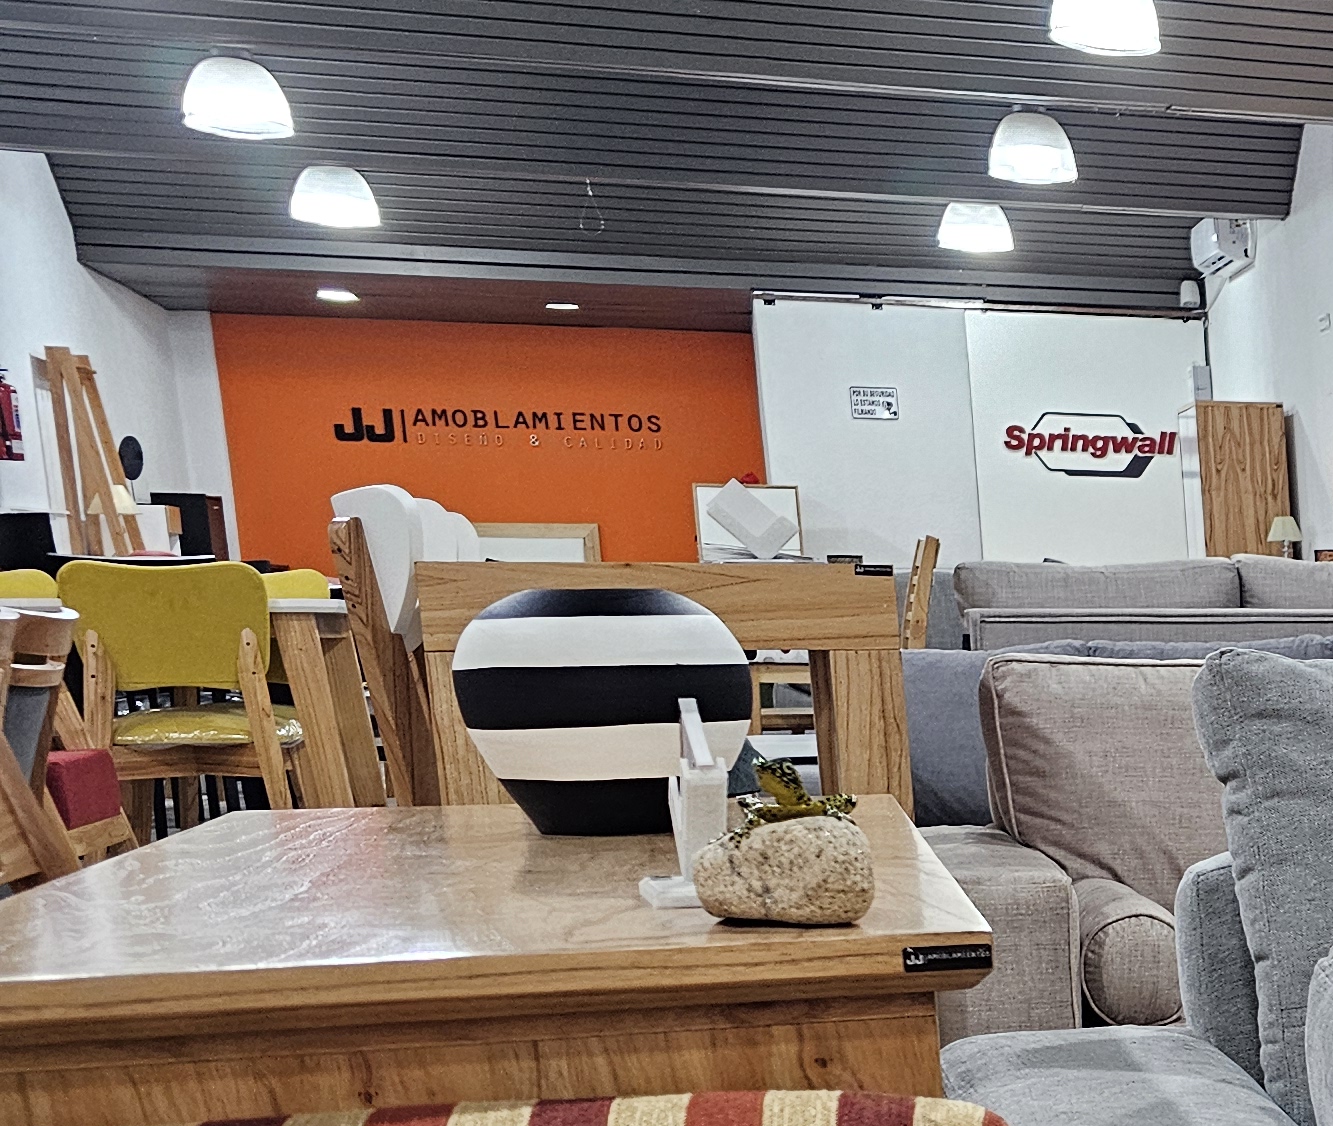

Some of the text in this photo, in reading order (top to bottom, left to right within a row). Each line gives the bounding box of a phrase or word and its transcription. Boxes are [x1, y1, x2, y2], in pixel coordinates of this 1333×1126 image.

[413, 408, 662, 433] AMOBLAMIENTOS
[529, 434, 540, 447] &
[564, 436, 663, 450] CALIDAD
[1003, 424, 1179, 459] Springwall
